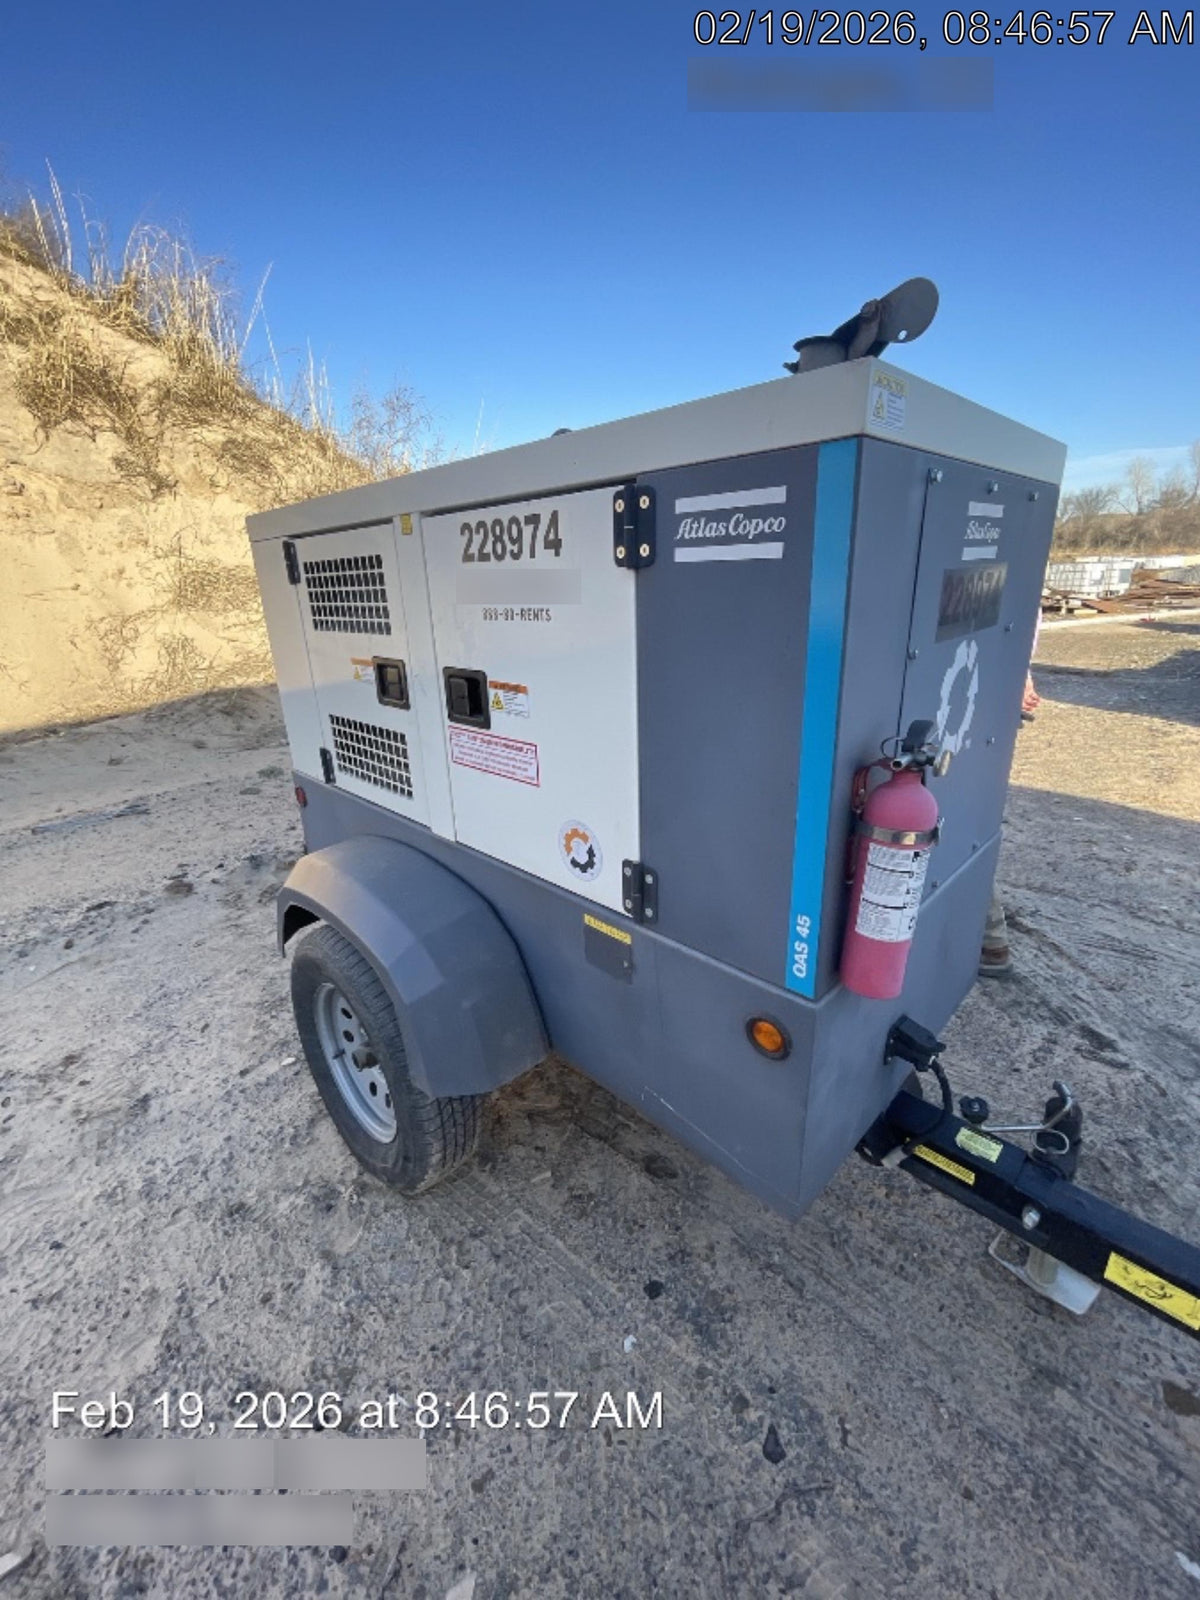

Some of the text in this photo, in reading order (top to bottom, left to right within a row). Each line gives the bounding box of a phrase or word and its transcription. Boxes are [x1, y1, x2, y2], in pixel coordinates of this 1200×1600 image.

[460, 509, 563, 563] 228974
[673, 513, 787, 540] Atlas Copco
[796, 912, 812, 939] 45
